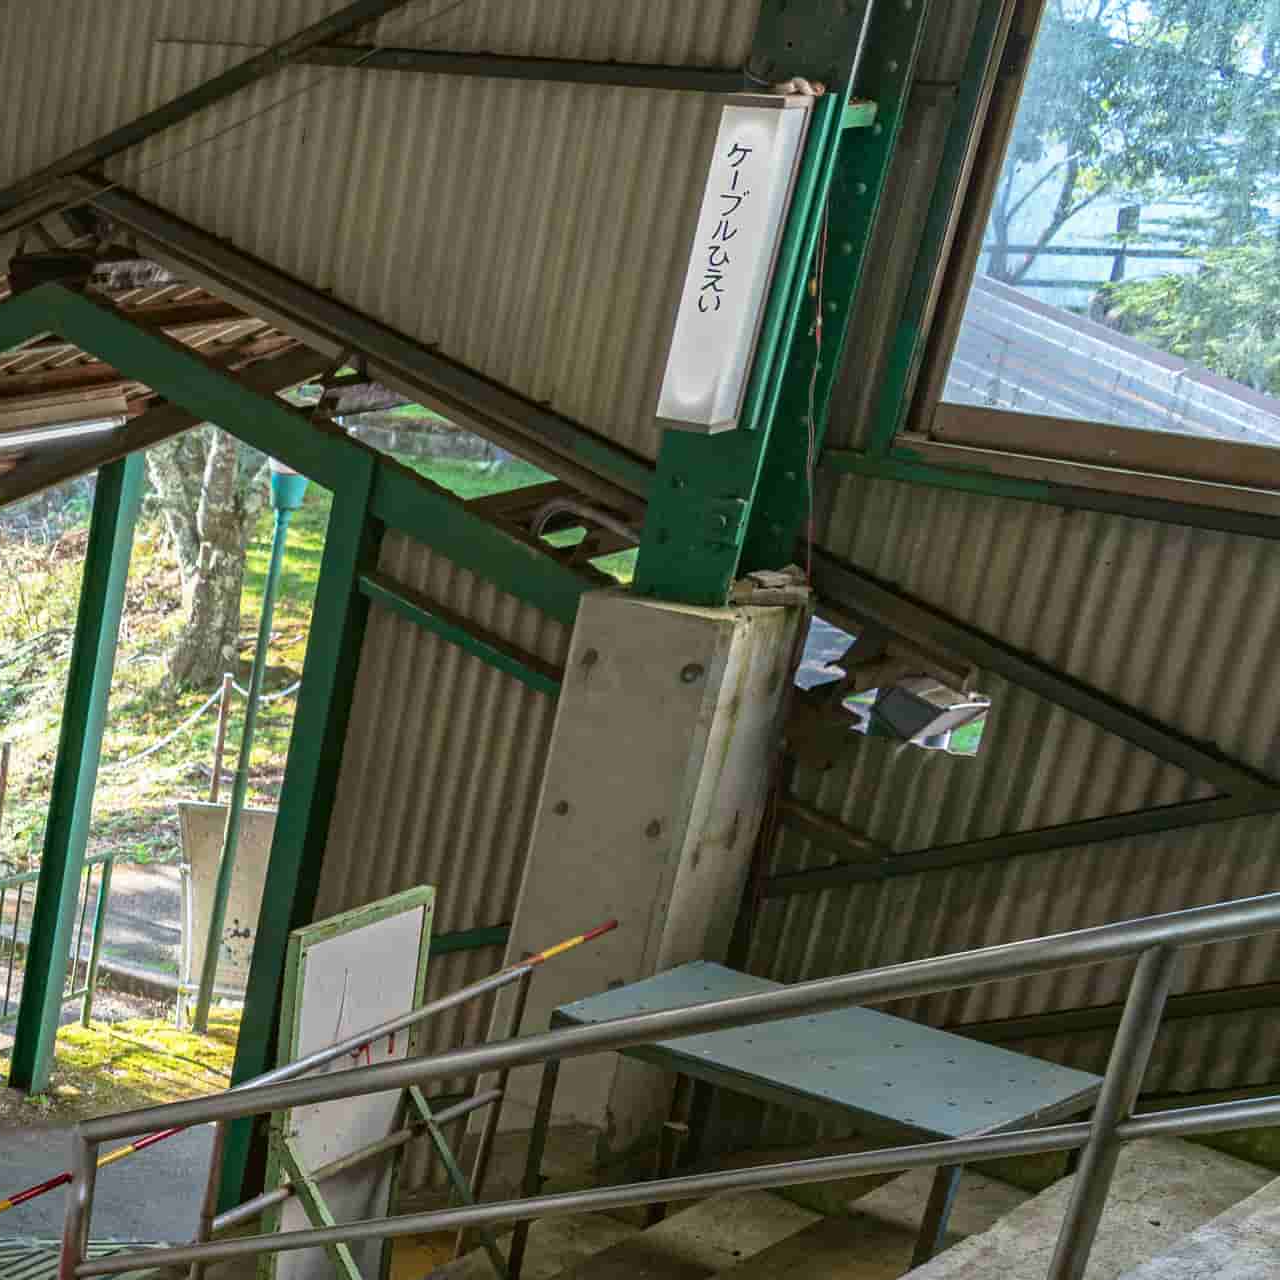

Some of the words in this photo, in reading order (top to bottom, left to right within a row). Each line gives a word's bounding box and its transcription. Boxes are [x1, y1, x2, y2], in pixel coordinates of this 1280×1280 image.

[698, 142, 753, 313] ケーブルひえい
